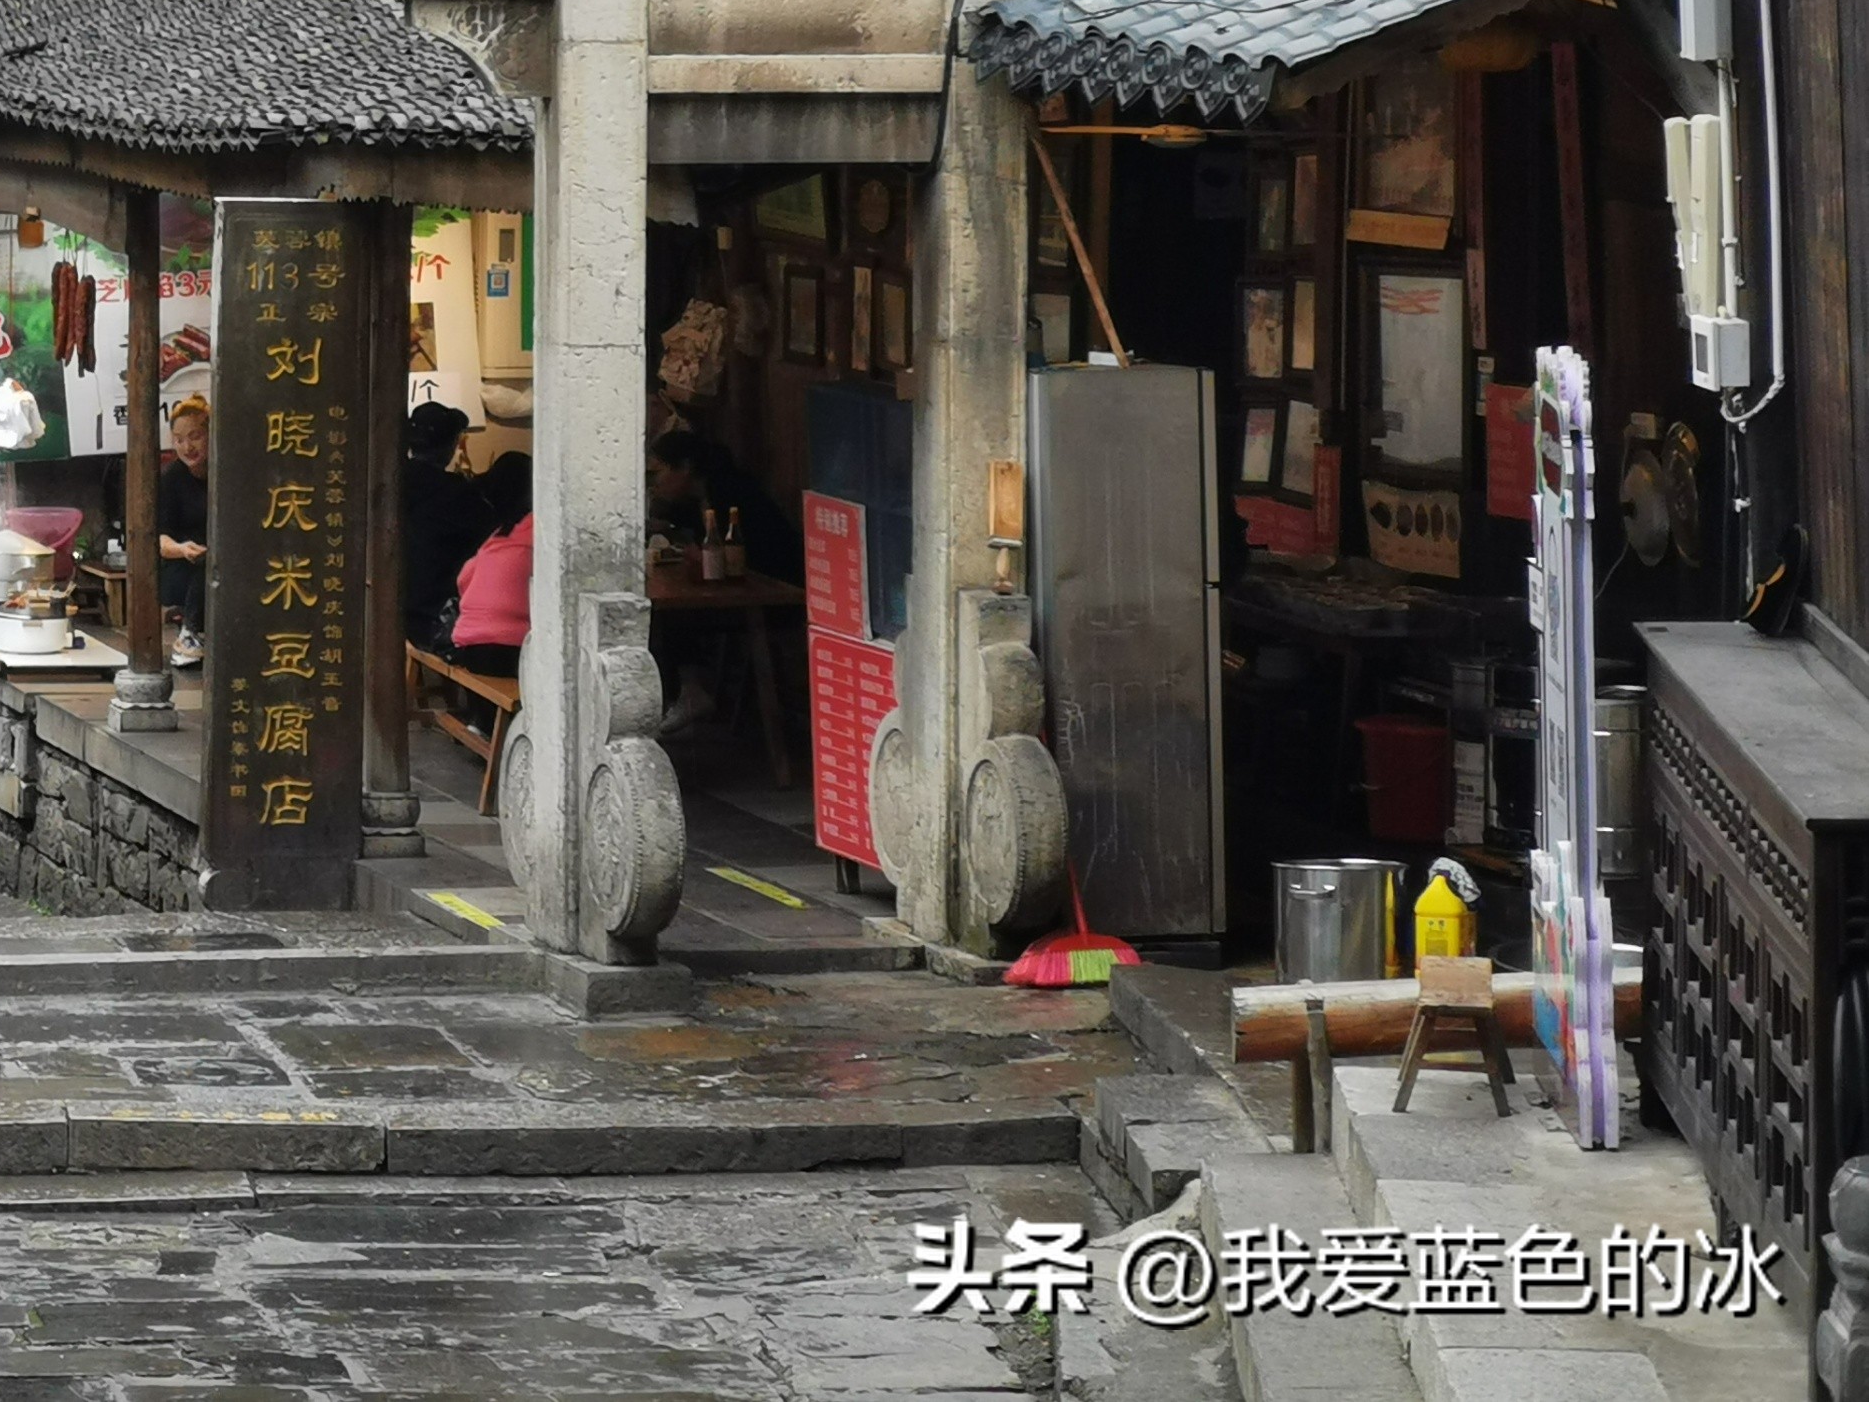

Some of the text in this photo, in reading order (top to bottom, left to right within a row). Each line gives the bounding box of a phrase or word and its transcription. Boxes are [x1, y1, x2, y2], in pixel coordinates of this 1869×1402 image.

[246, 262, 346, 291] 113号
[256, 303, 338, 322] 正宗
[257, 338, 319, 825] 刘晓庆米豆腐店
